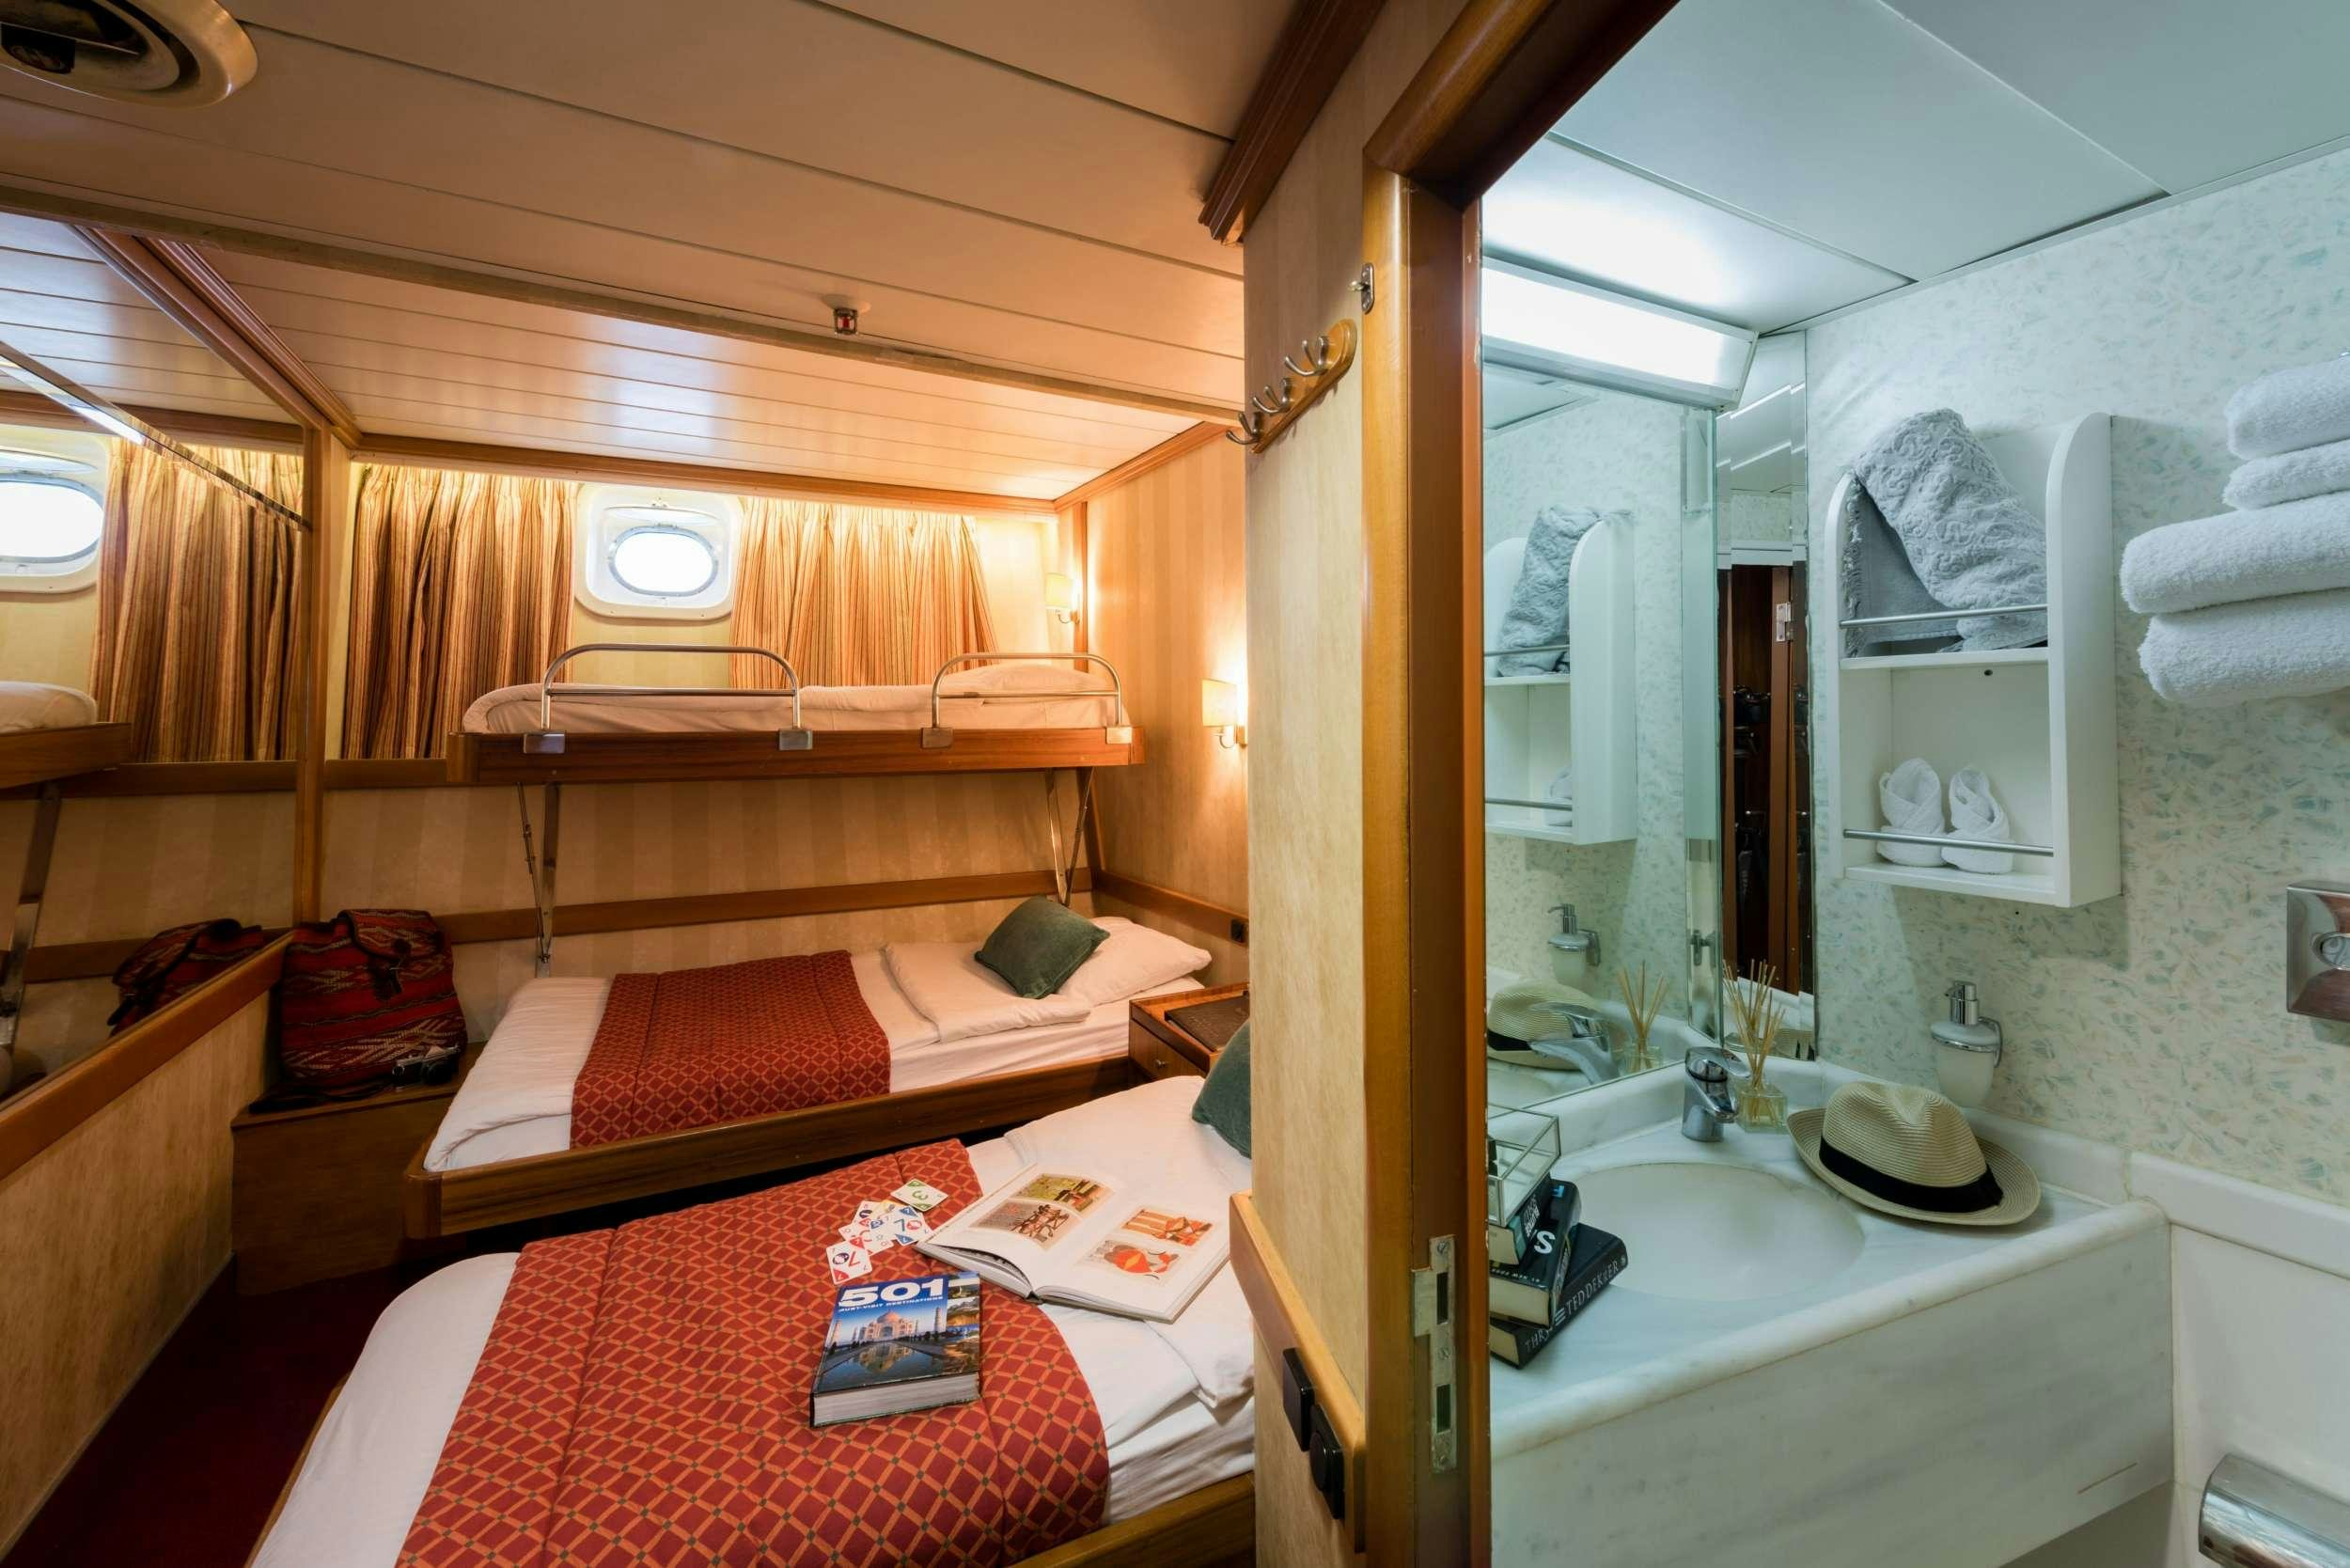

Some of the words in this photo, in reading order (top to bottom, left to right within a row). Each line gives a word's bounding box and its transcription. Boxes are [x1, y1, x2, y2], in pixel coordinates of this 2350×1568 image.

[913, 1190, 928, 1200] 3
[894, 1218, 905, 1232] 7
[849, 1250, 861, 1267] 7
[838, 1278, 944, 1308] 501
[1566, 1289, 1586, 1315] TED
